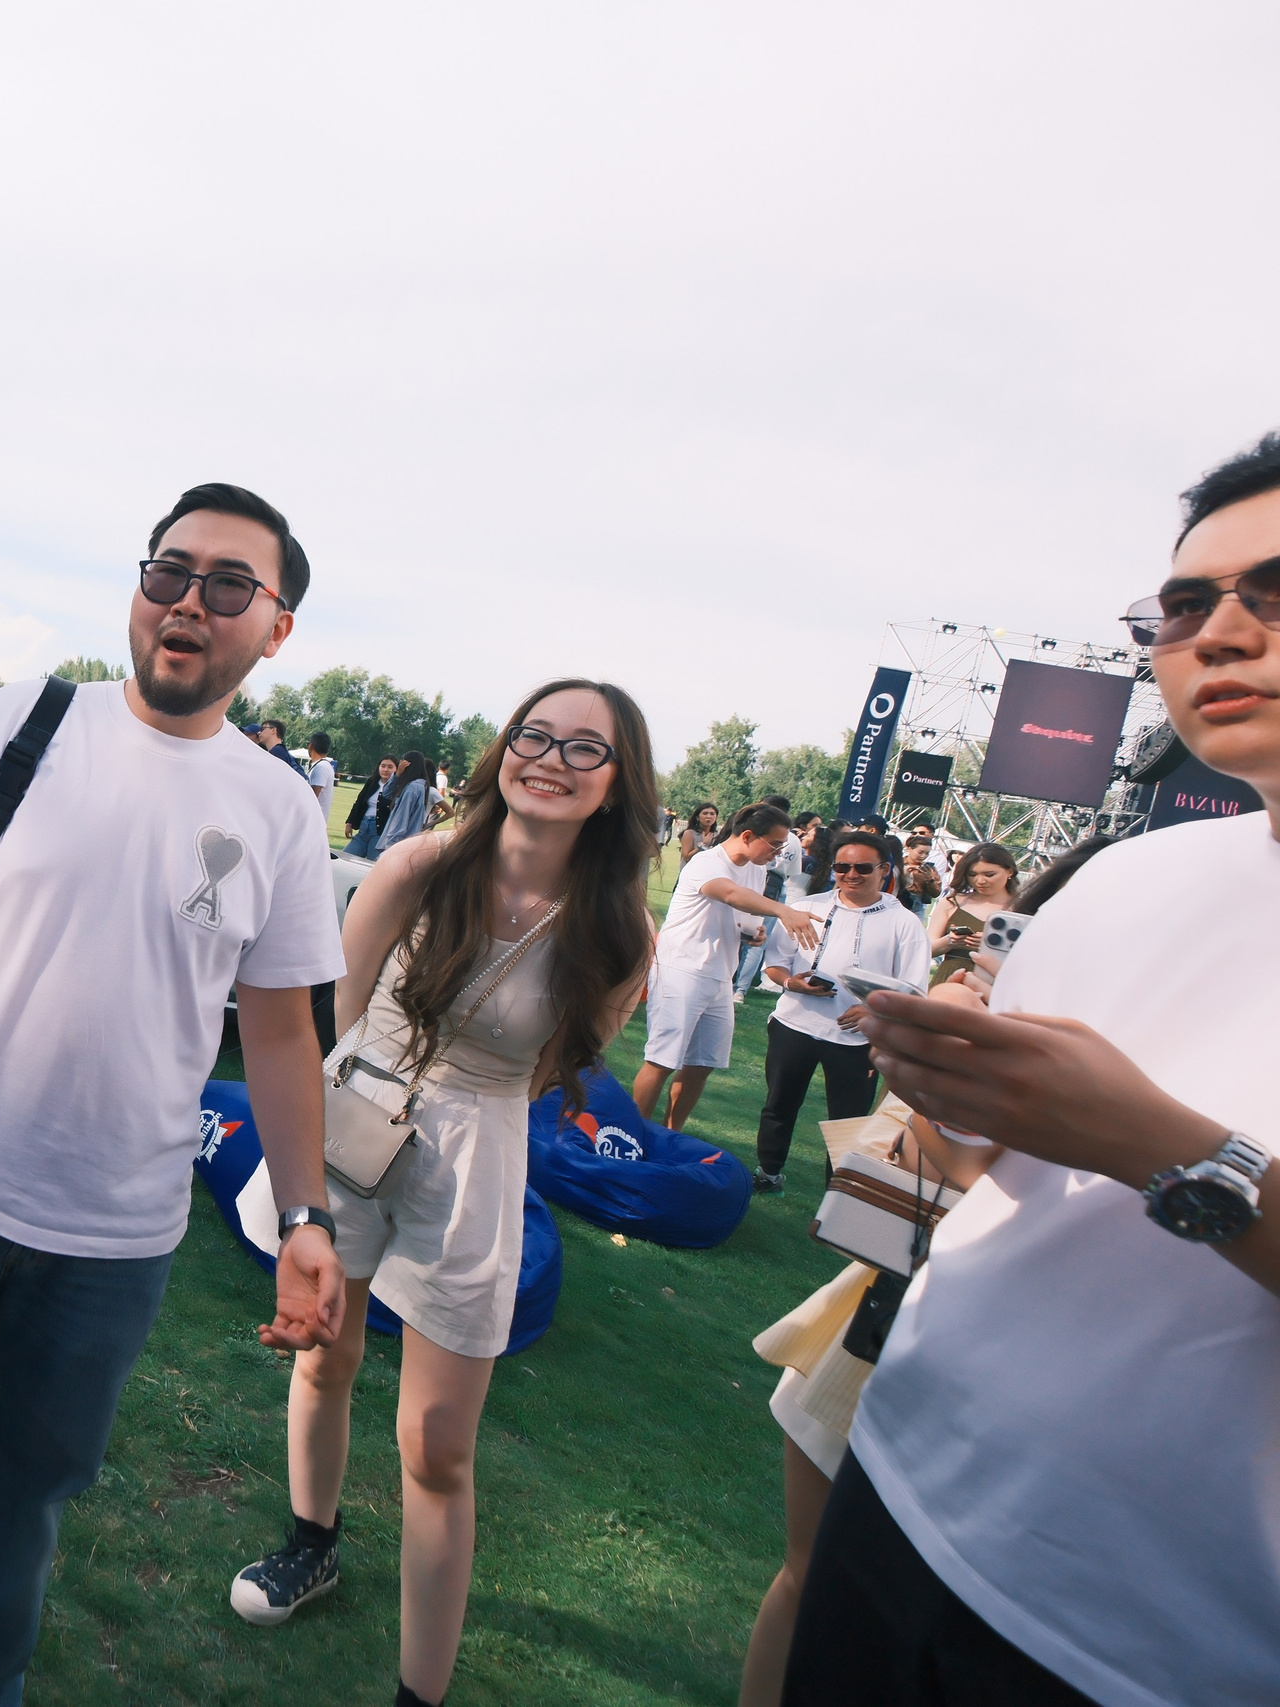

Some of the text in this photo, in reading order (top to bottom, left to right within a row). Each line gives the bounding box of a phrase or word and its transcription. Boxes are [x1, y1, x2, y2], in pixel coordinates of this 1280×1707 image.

[849, 722, 883, 803] Partners
[912, 774, 944, 786] Partners
[1174, 792, 1239, 816] BAZAAR
